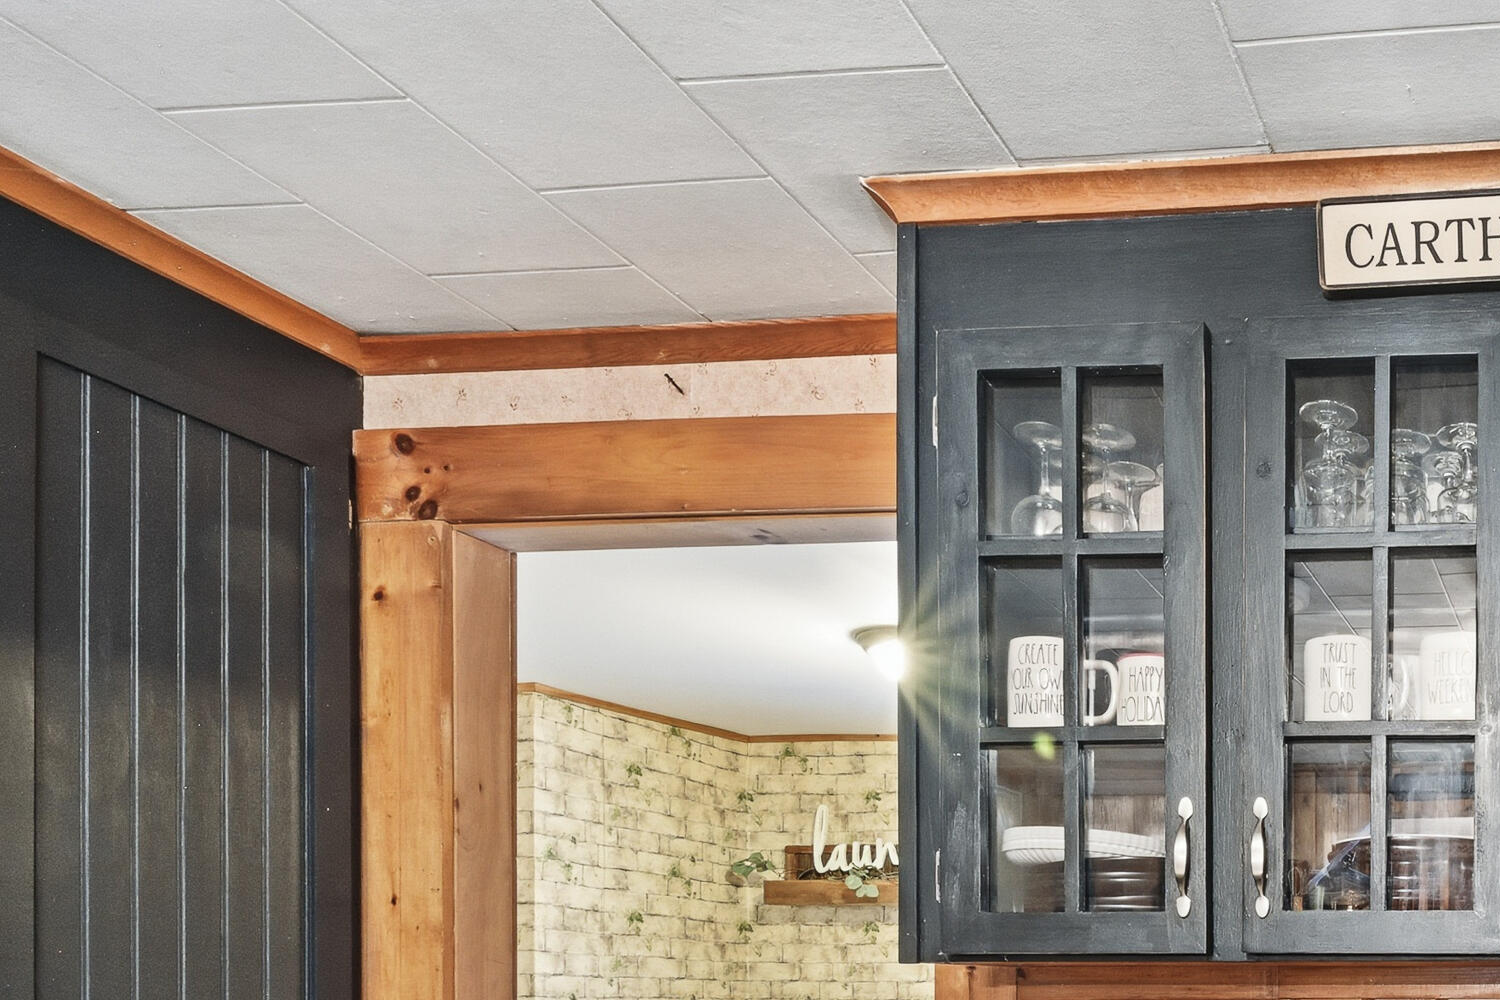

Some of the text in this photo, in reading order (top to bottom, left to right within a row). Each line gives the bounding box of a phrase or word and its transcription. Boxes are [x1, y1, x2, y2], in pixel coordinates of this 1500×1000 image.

[1018, 643, 1058, 666] CREATE
[1322, 642, 1357, 664] TRUST
[1008, 667, 1034, 690] OUR
[1129, 665, 1163, 692] HAPPY
[1320, 666, 1357, 690] IN THE
[1323, 691, 1355, 714] LORD
